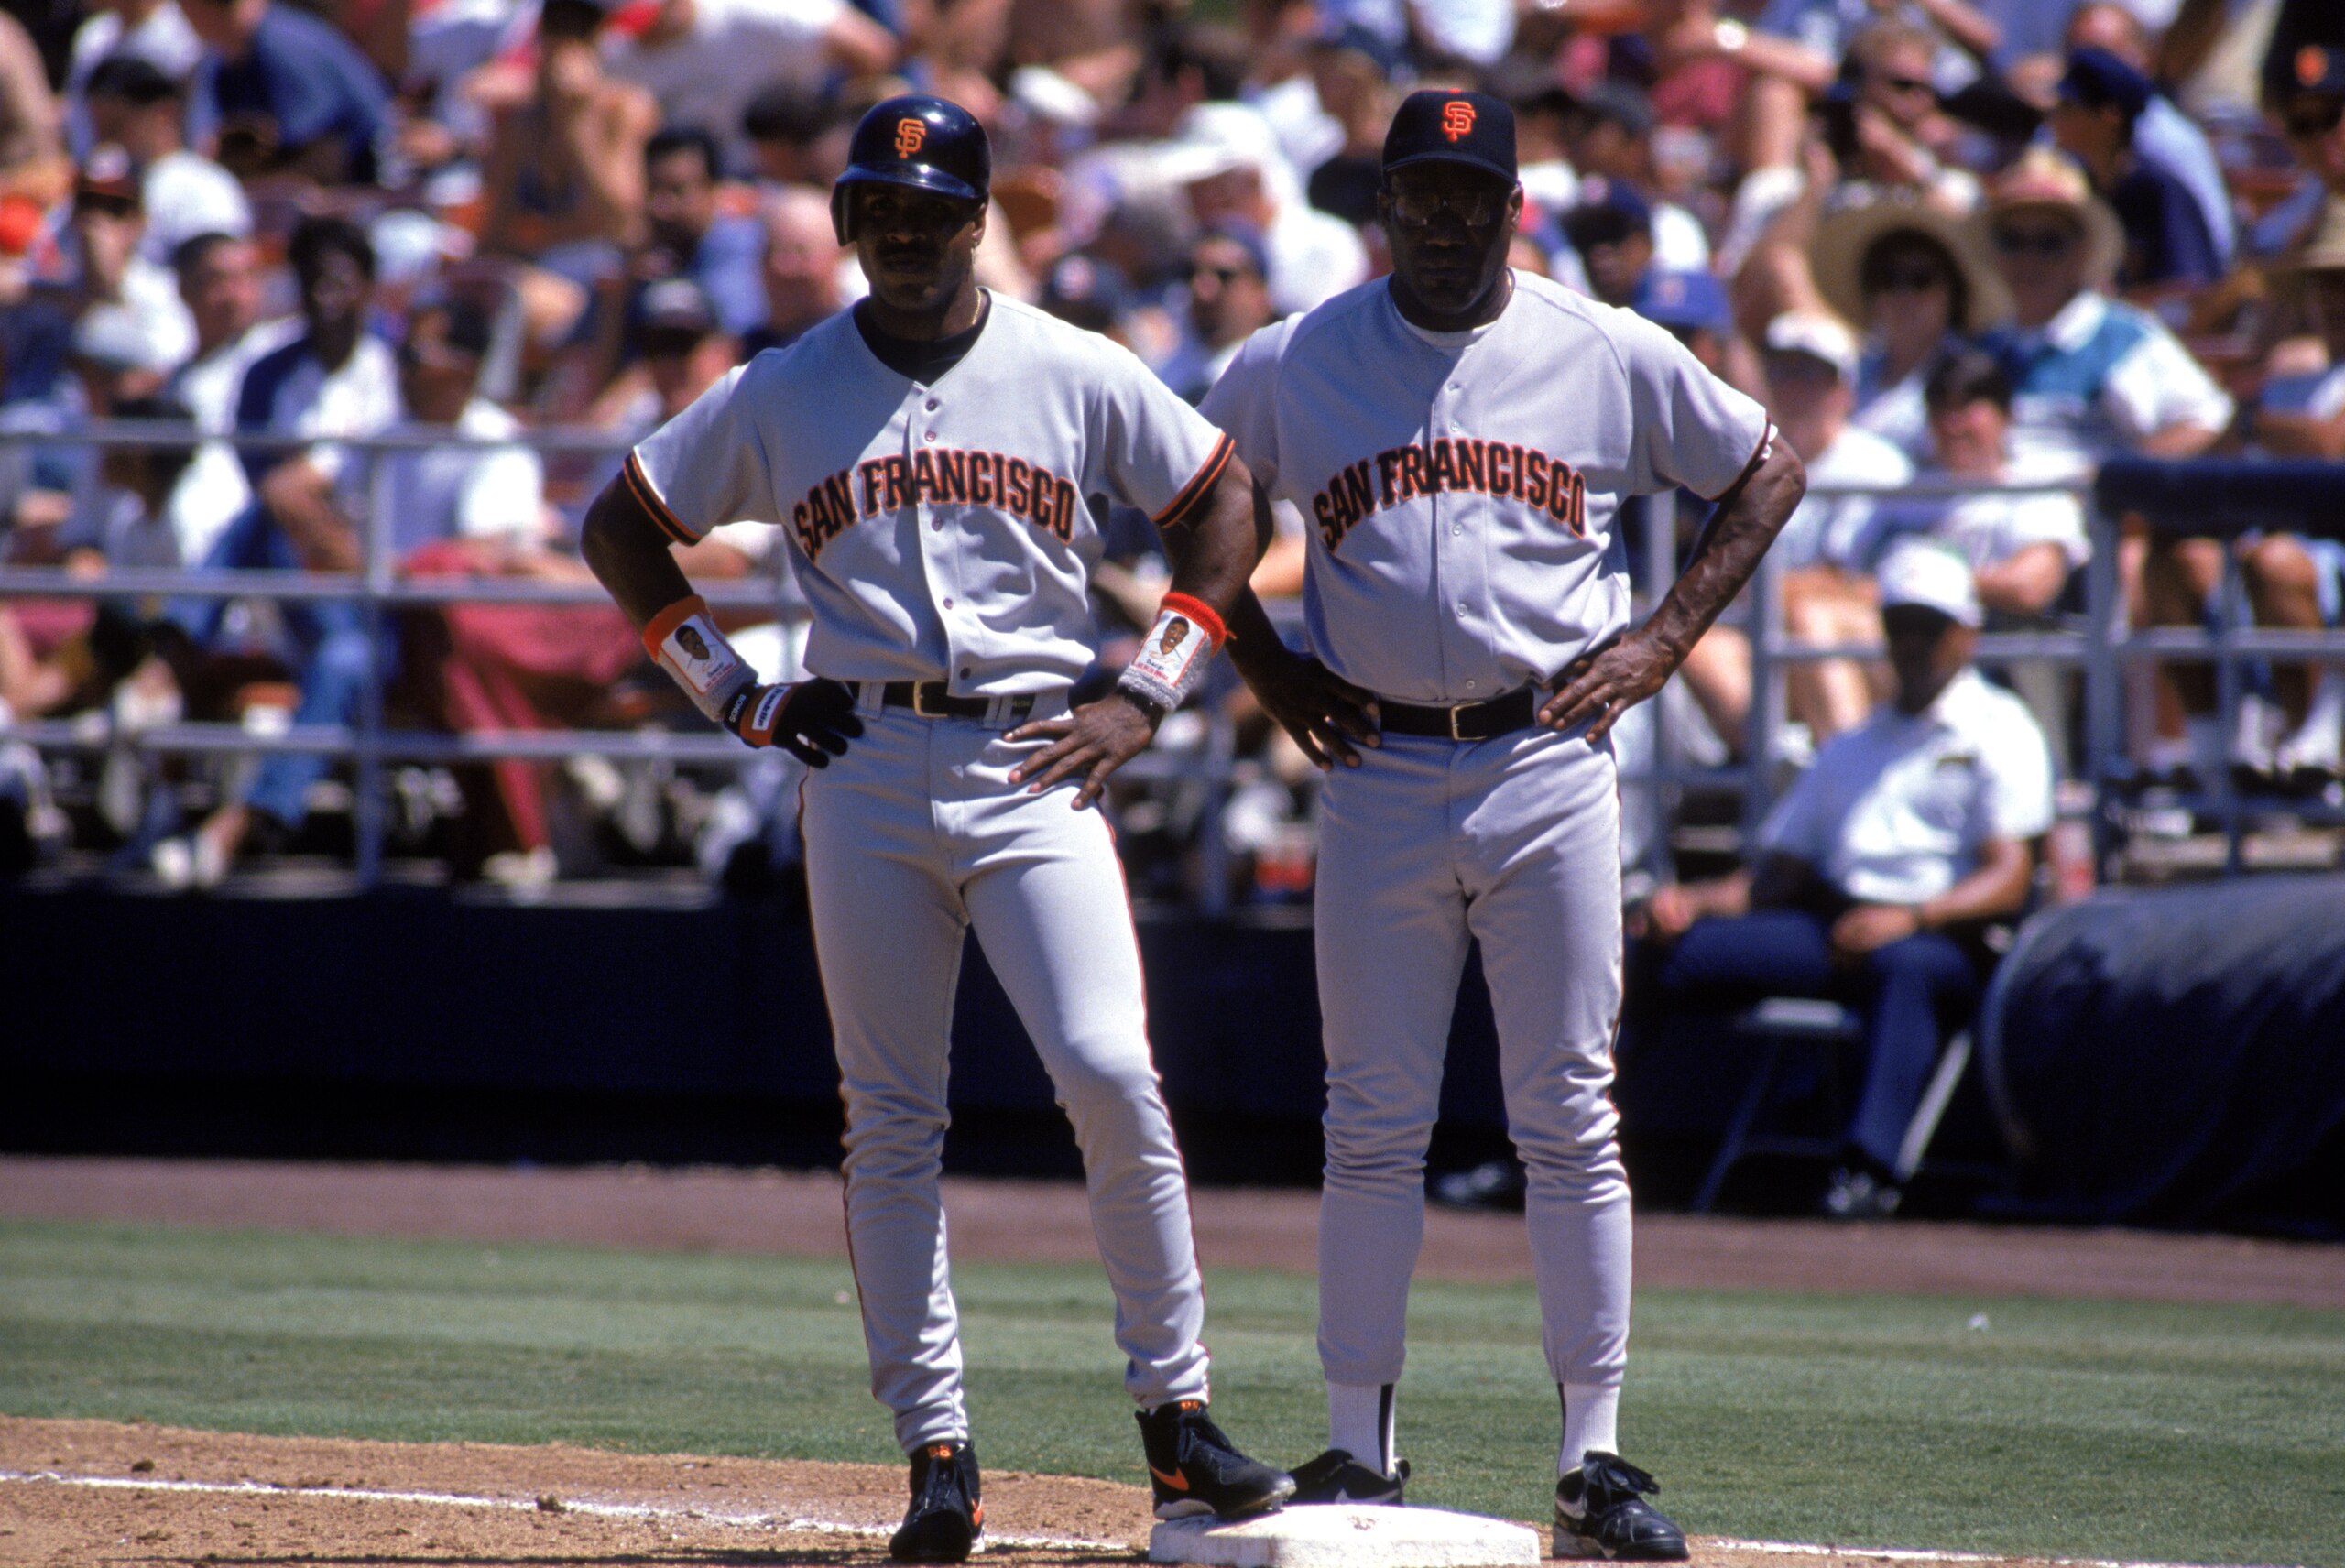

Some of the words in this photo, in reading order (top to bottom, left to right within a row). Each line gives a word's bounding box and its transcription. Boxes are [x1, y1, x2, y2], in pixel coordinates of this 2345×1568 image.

[894, 117, 927, 159] SF
[1441, 101, 1477, 143] SF
[793, 468, 859, 563] SAN
[858, 448, 1076, 546] FRANCISCO
[1313, 458, 1378, 554] SAN
[1376, 438, 1586, 540] FRANCISCO
